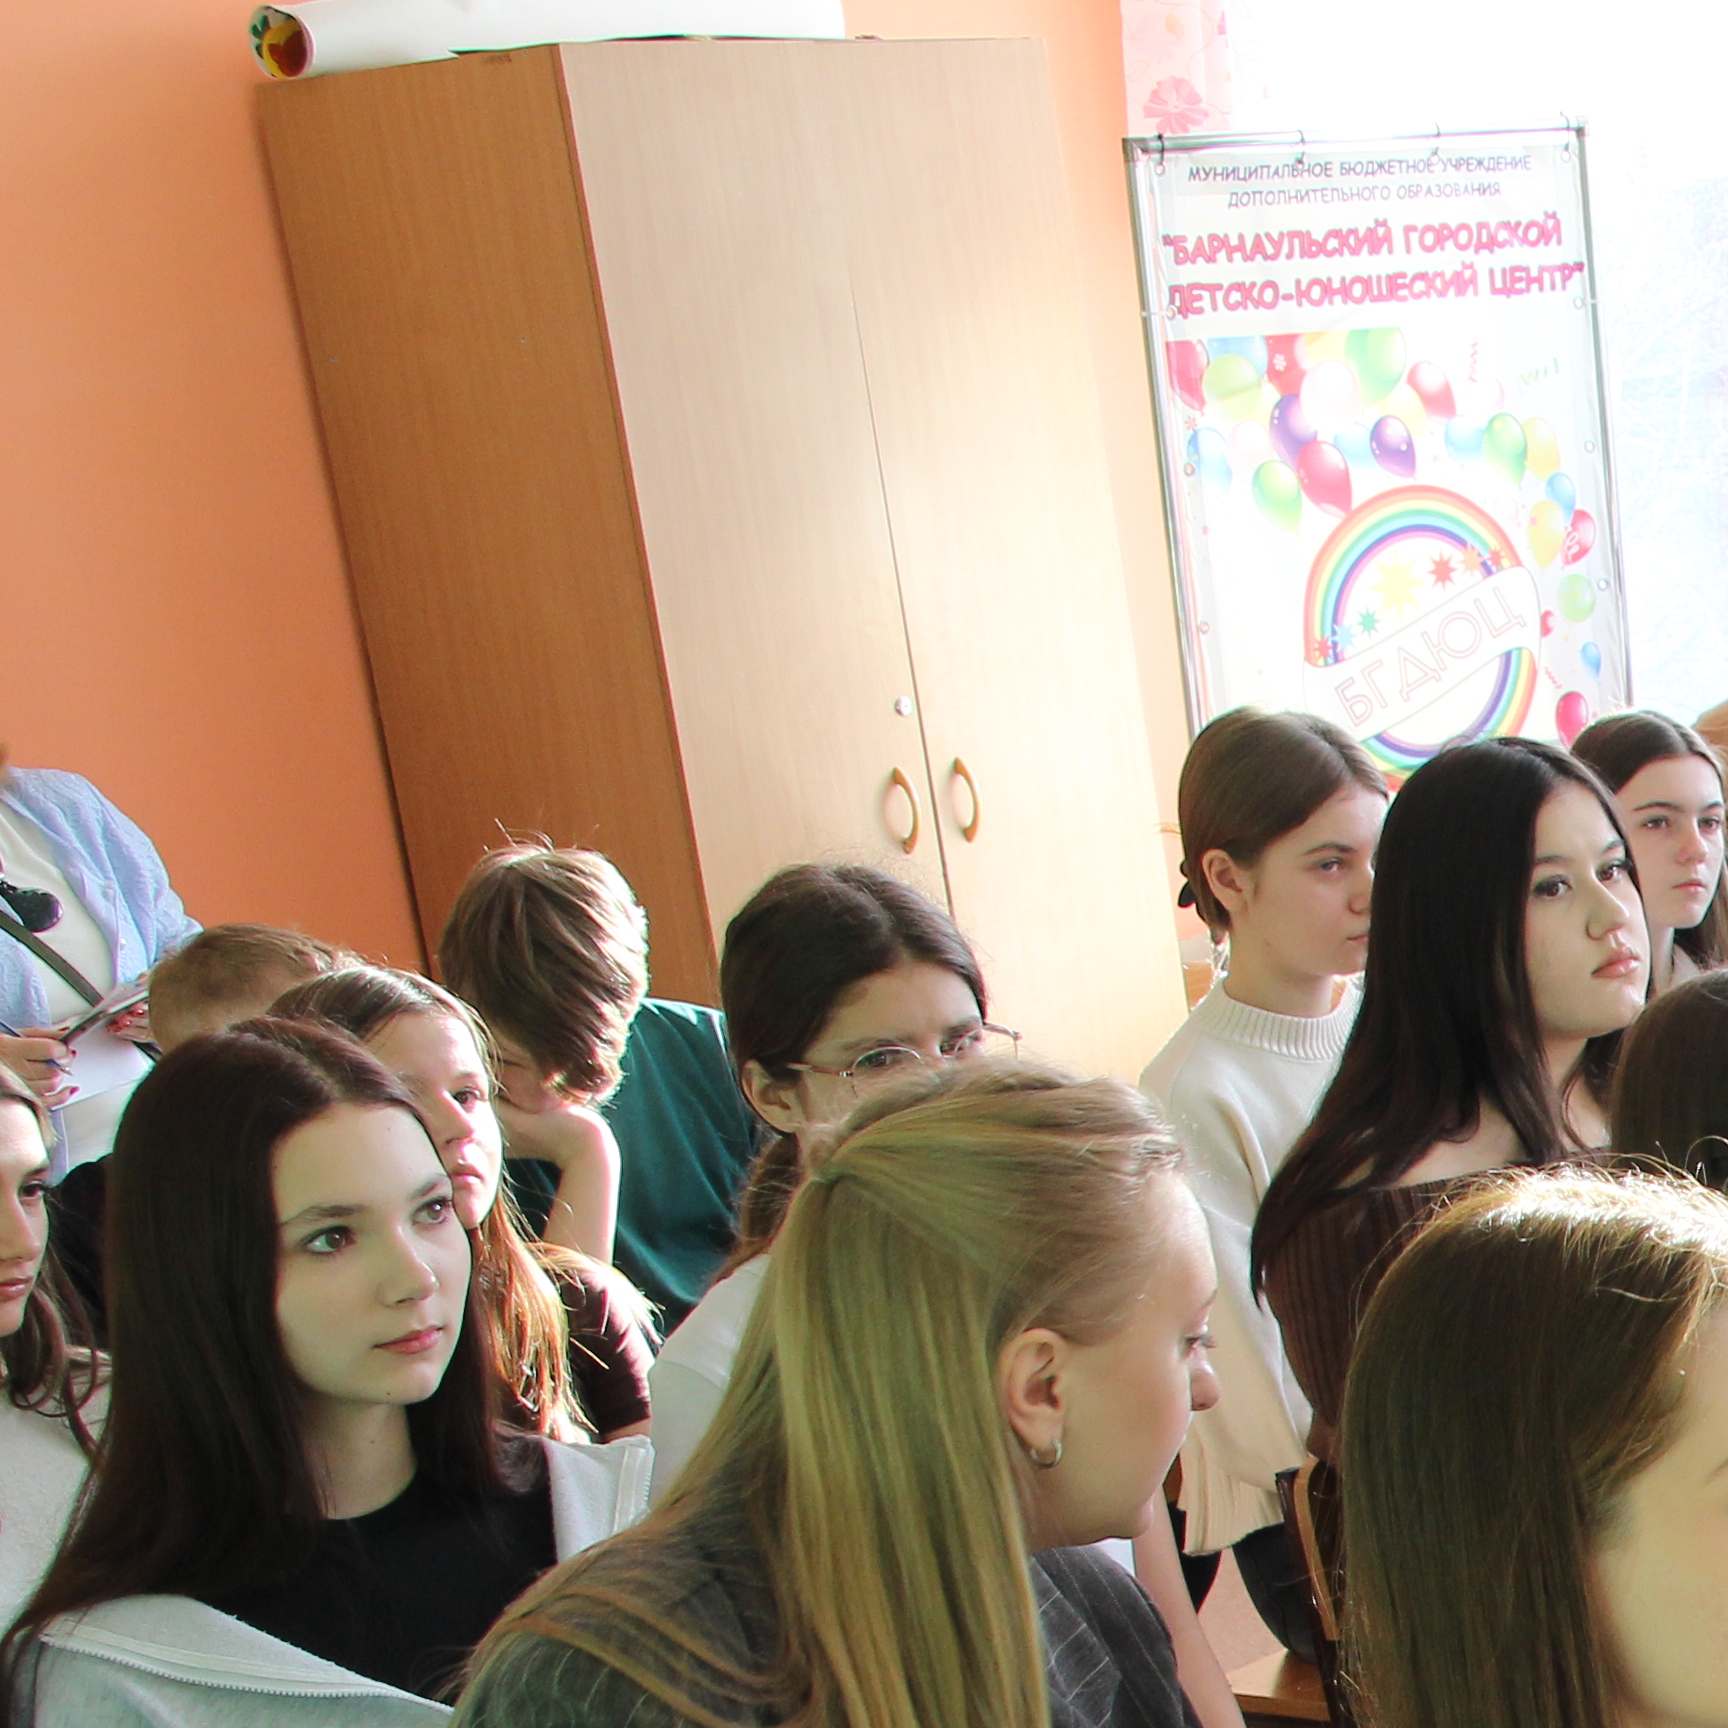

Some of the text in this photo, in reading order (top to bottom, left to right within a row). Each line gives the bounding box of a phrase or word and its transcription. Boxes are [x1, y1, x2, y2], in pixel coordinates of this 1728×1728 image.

[1188, 155, 1532, 182] МУНИЦИПАЛЬНОЕ БЮДЖЕТНОЕ УЧРЕЖДЕНИЕ
[1228, 181, 1501, 209] ДОПОЛНИТЕЛЬНОГО ОБРАЗОВАНИЯ
[1402, 209, 1563, 255] ГОРОДСКОЙ
[1168, 260, 1479, 319] ДЕТСКО-ЮНОШЕСКИЙ
[1334, 586, 1528, 727] БГДЮЦ
